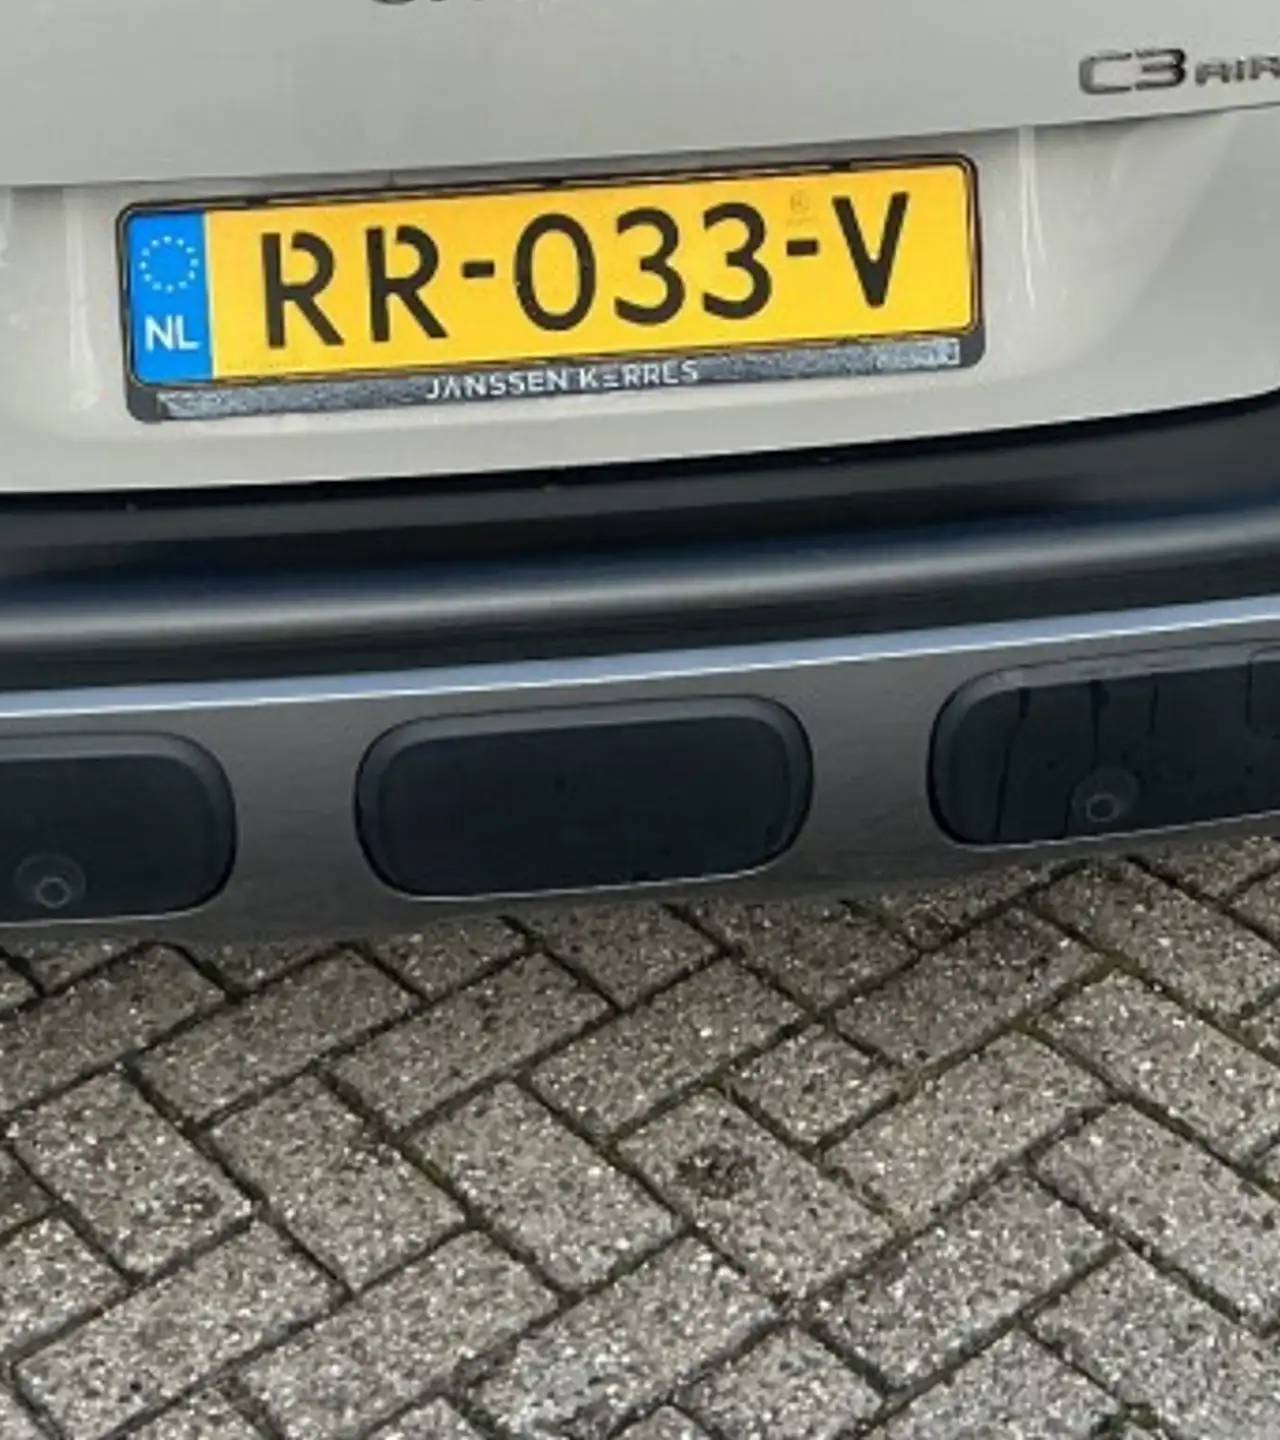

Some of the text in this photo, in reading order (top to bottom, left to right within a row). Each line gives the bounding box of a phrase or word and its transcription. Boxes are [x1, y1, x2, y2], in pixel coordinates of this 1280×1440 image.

[1078, 47, 1188, 96] C3
[260, 191, 910, 351] RR-033-V
[144, 314, 201, 353] NL
[424, 365, 568, 400] JANSSEN
